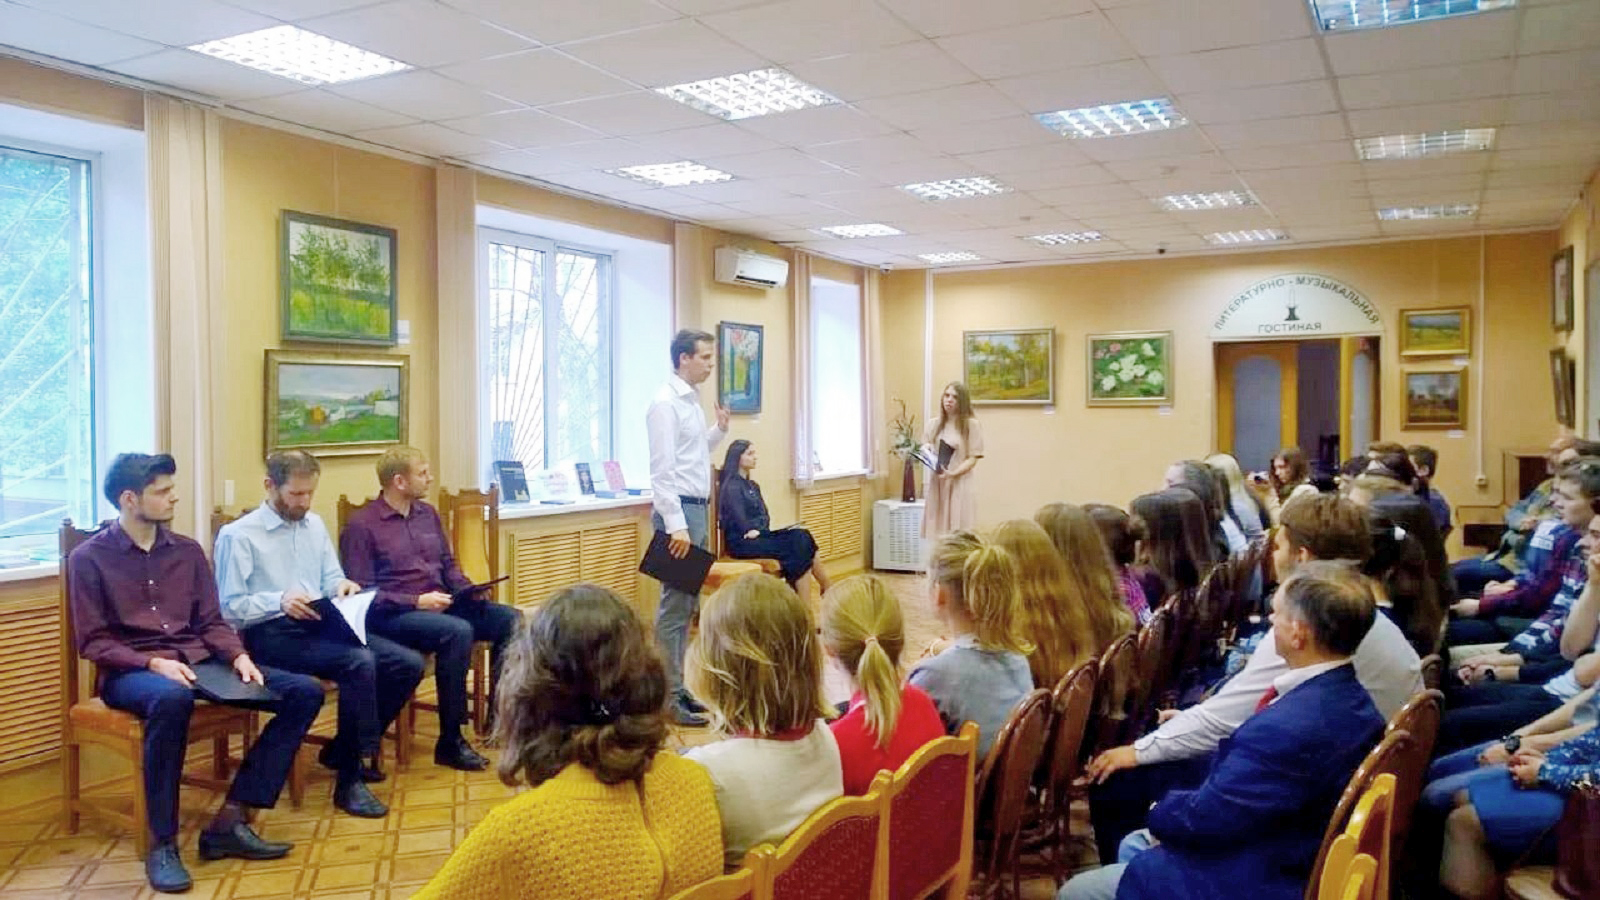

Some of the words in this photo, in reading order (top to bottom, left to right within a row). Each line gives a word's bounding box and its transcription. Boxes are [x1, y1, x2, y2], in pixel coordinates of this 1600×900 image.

[1214, 278, 1285, 330] ЛИТЕРАТУРНО
[1295, 276, 1379, 325] МУЗЫКАЛЬНАЯ
[1258, 322, 1322, 334] ГОСТИНАЯ
